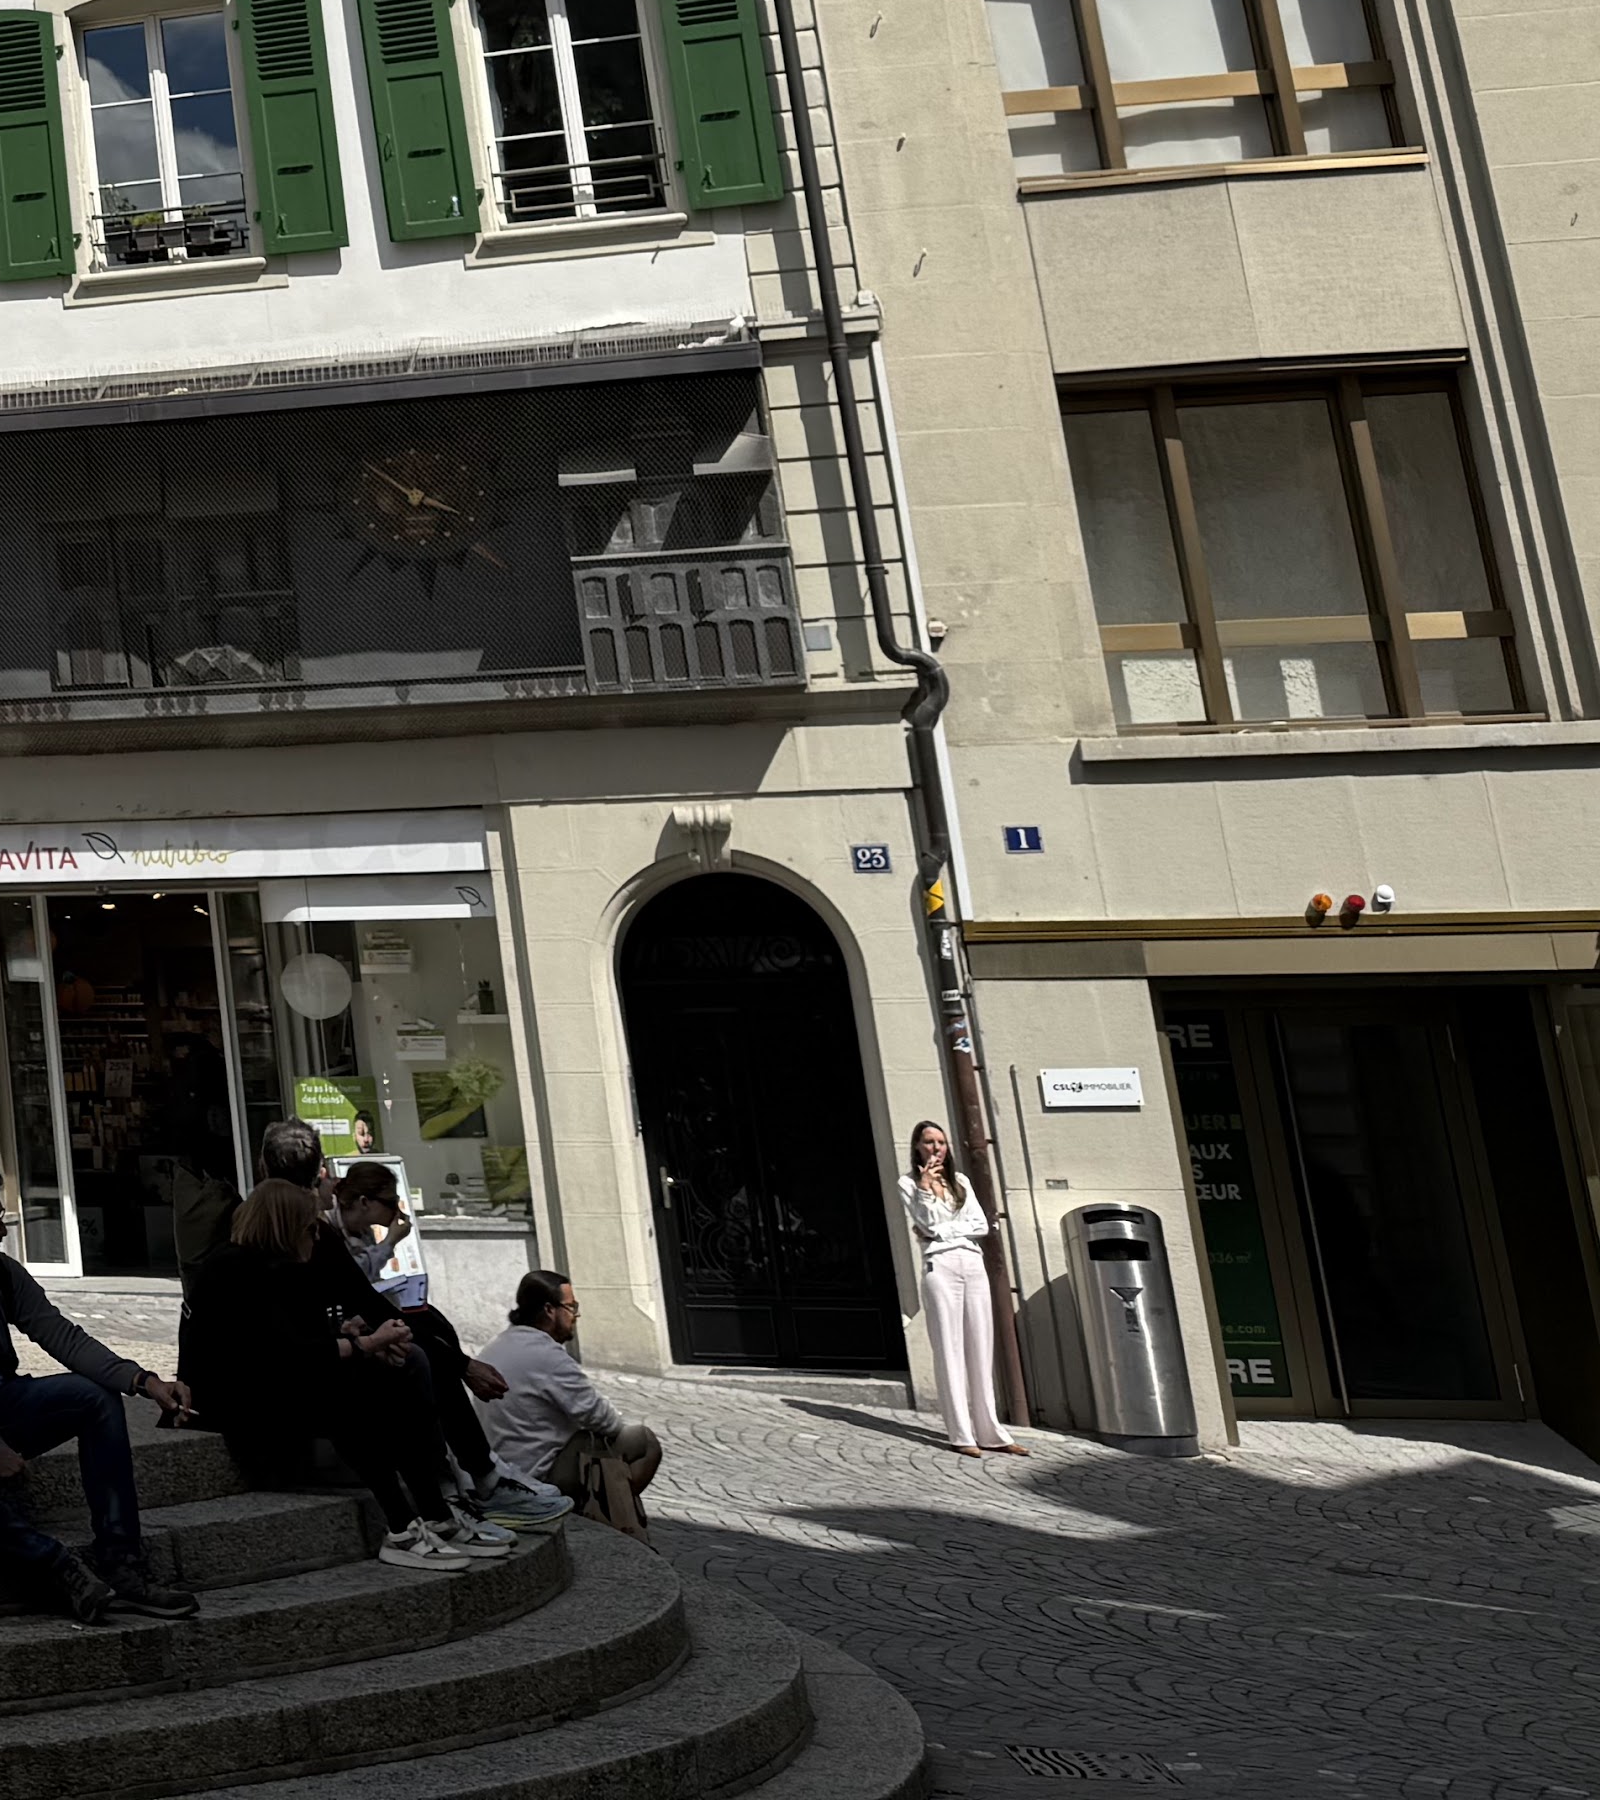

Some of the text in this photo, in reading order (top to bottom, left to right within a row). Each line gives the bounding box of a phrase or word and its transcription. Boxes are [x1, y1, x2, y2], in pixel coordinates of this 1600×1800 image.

[1016, 828, 1030, 849] 1
[131, 838, 241, 868] nutribio
[856, 848, 886, 869] 23
[300, 1083, 314, 1093] Tu
[1052, 1083, 1071, 1091] CSL
[301, 1094, 345, 1104] des foins?
[1225, 1358, 1275, 1384] RE
